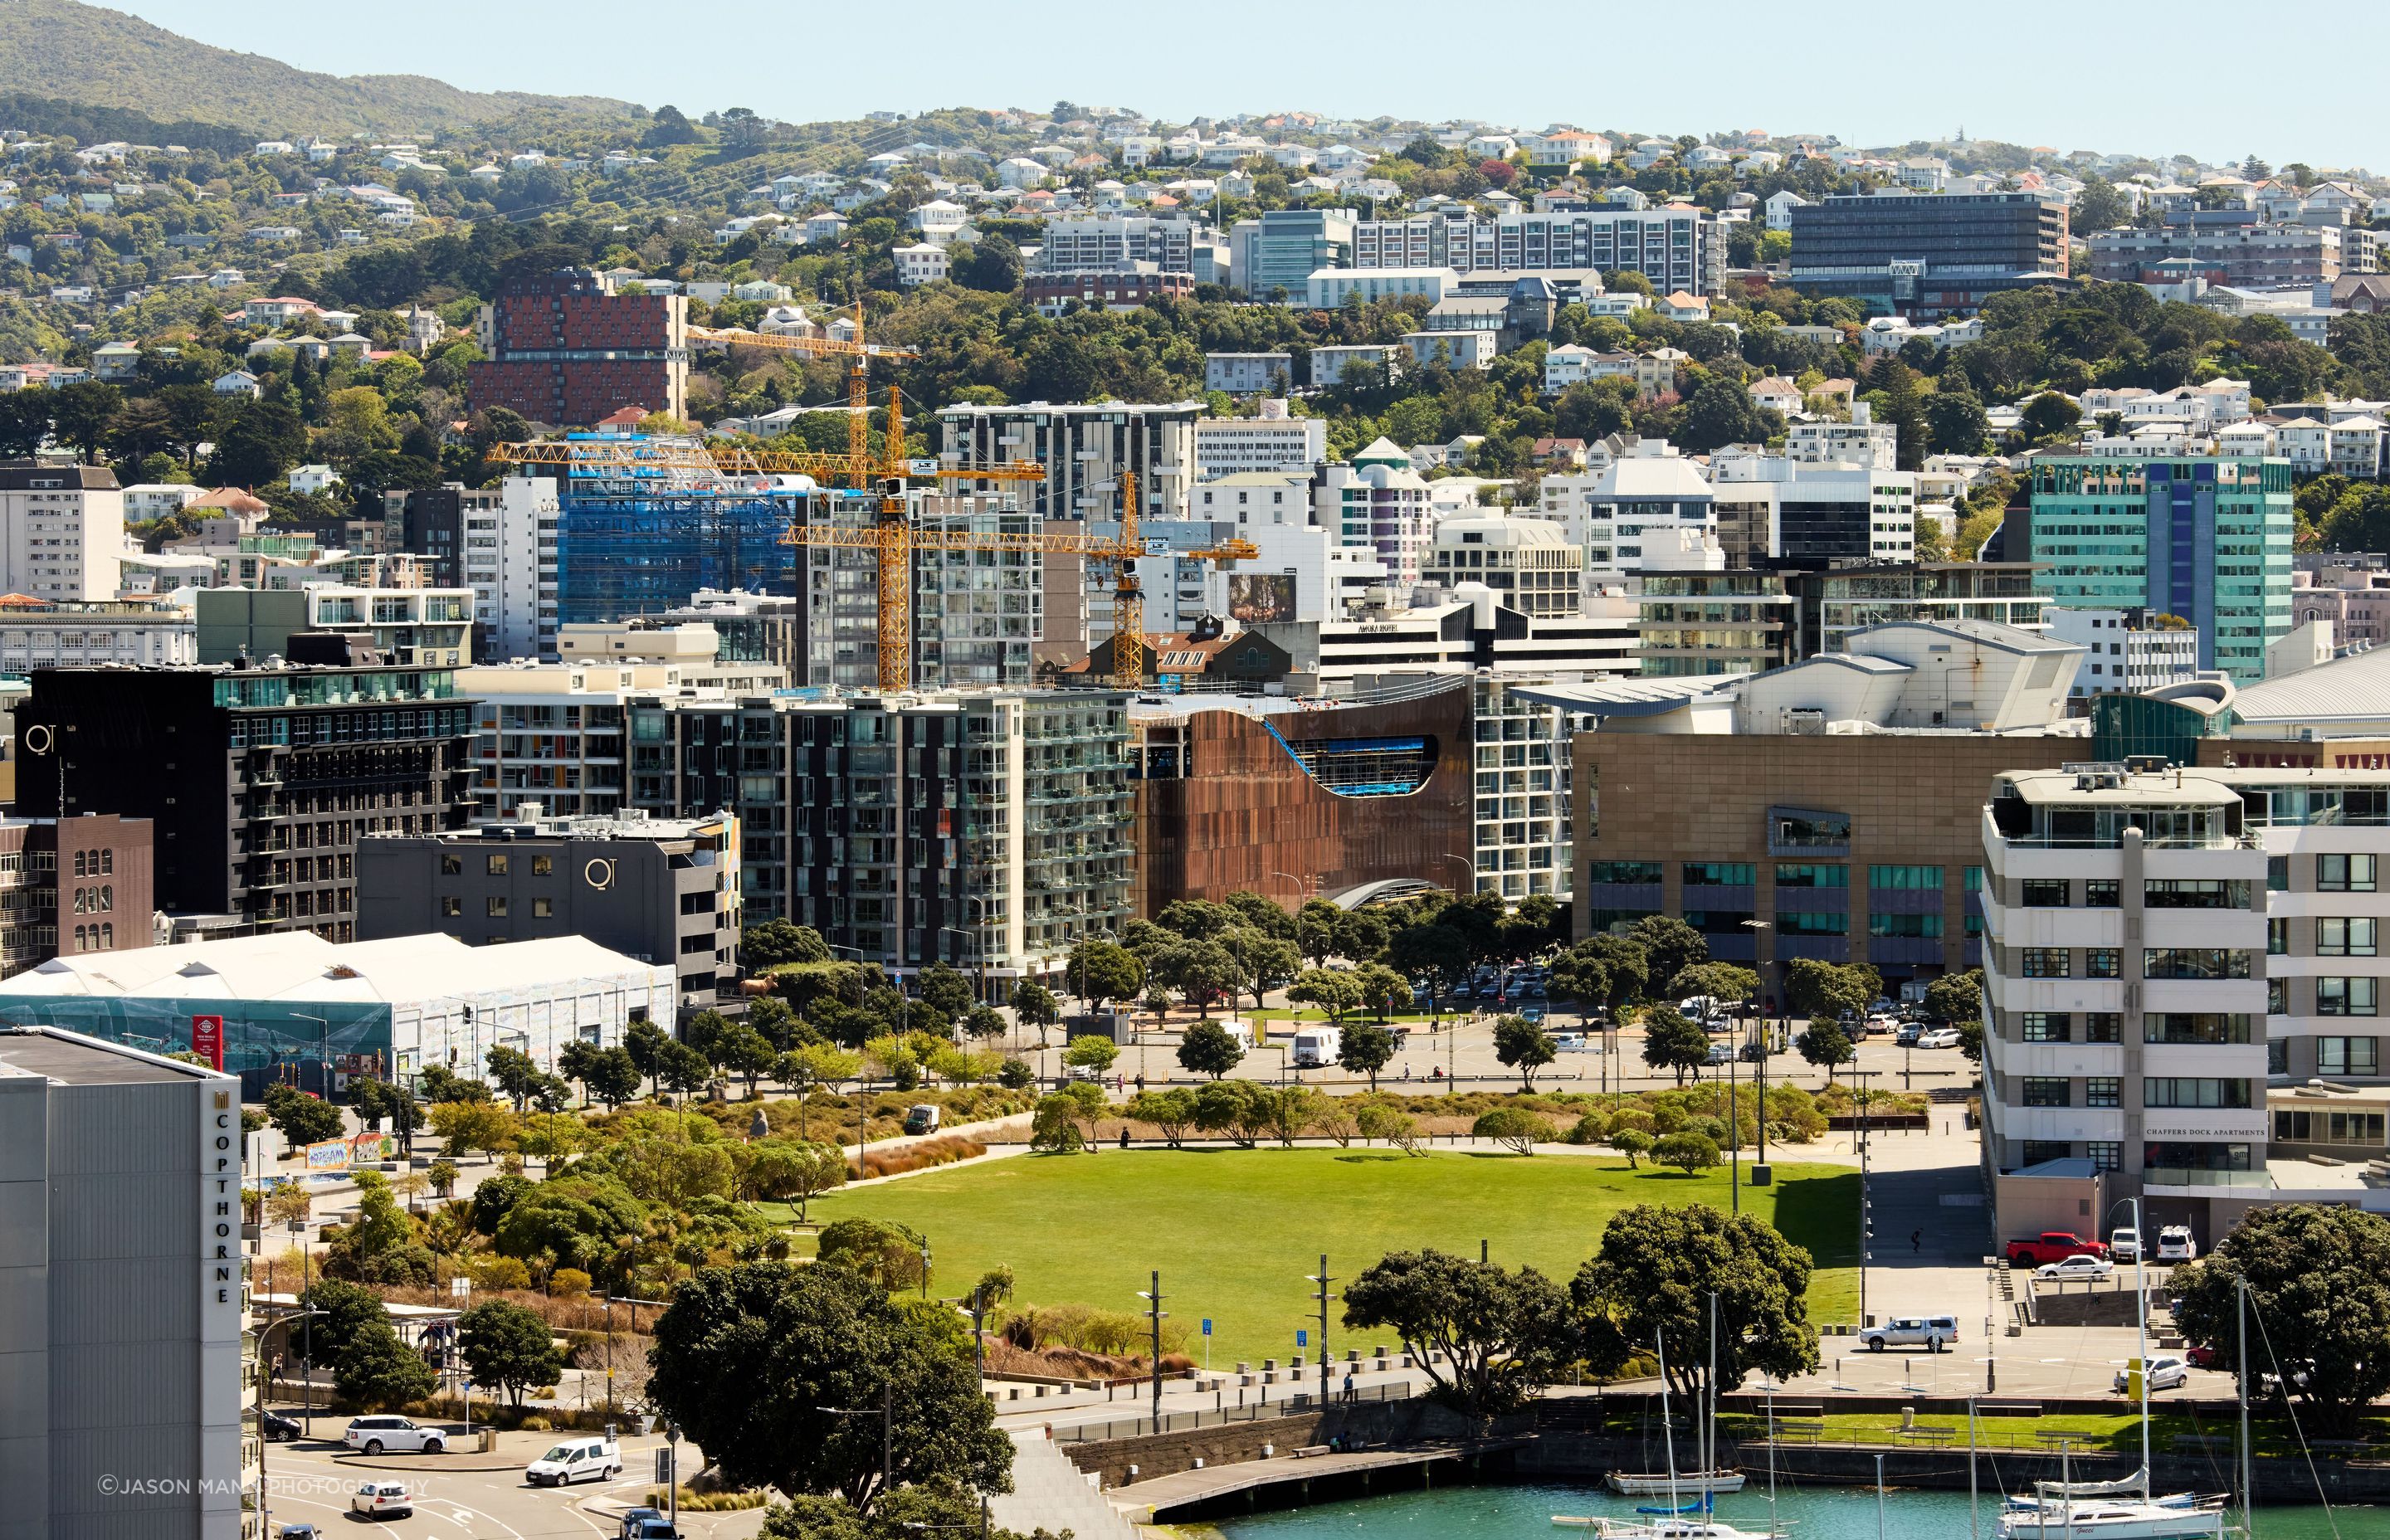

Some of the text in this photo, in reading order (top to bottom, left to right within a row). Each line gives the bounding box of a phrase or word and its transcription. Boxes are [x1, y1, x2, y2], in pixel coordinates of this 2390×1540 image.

[1358, 624, 1378, 632] AMORA
[26, 725, 56, 755] QT
[585, 858, 617, 890] QT
[216, 1114, 230, 1303] COPTHORNE
